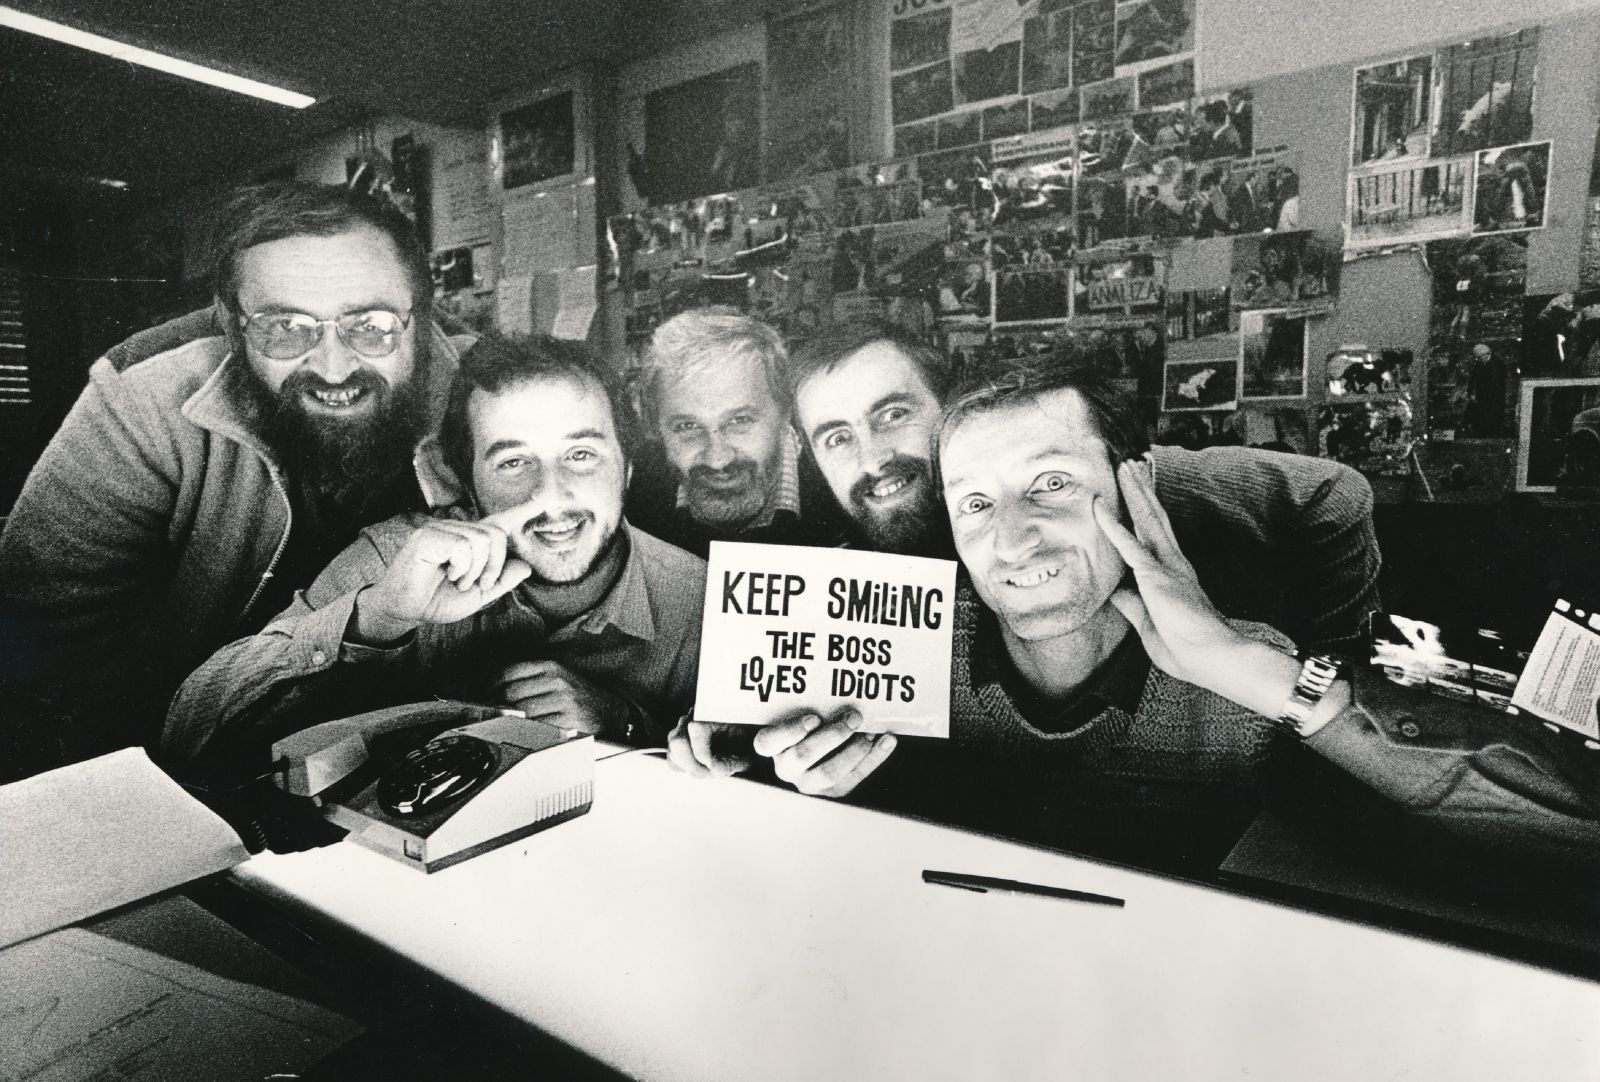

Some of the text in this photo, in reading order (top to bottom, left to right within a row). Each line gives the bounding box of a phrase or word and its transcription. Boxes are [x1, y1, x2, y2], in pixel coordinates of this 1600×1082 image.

[721, 570, 806, 616] KEEP
[766, 630, 892, 666] THE BOSS
[740, 656, 807, 702] LOVES
